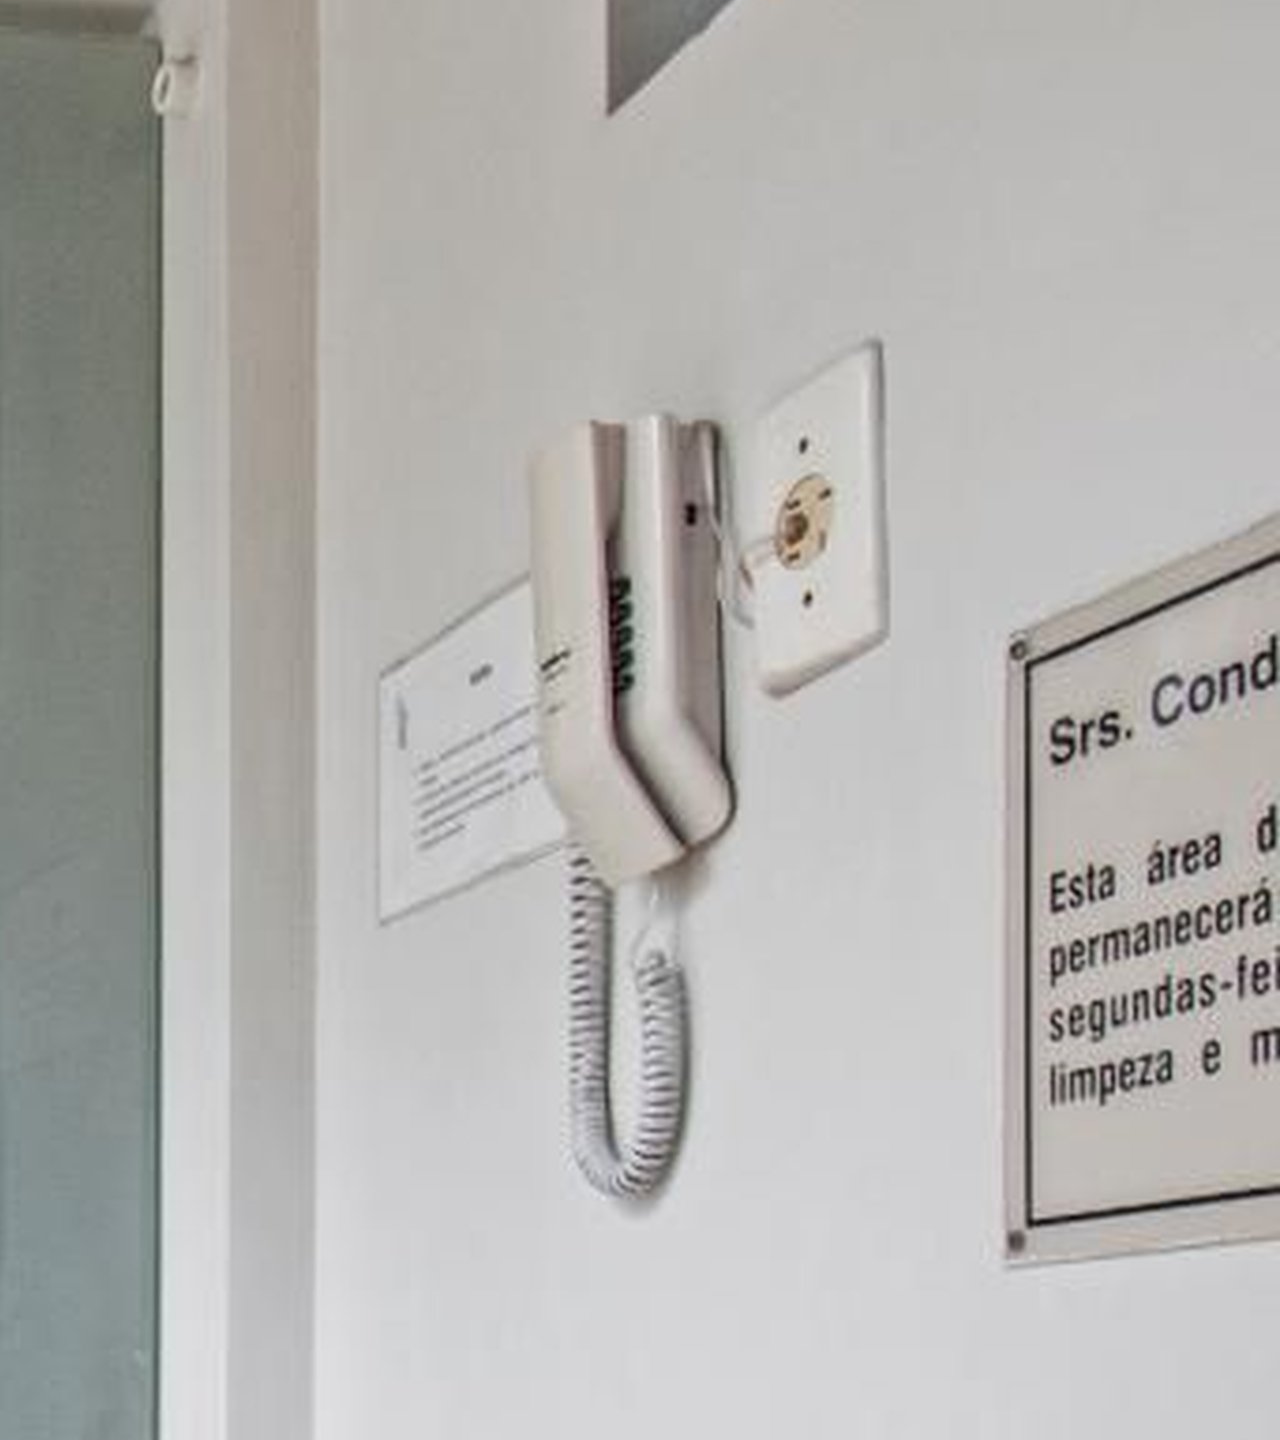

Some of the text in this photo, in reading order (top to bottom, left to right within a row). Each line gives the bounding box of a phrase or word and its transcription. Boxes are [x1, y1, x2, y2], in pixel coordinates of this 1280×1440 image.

[1050, 710, 1133, 765] Srs.
[1049, 862, 1116, 915] Esta
[1147, 832, 1221, 886] área
[1050, 877, 1272, 988] permanecerá
[1050, 1049, 1173, 1106] limpeza
[1202, 1039, 1221, 1076] e
